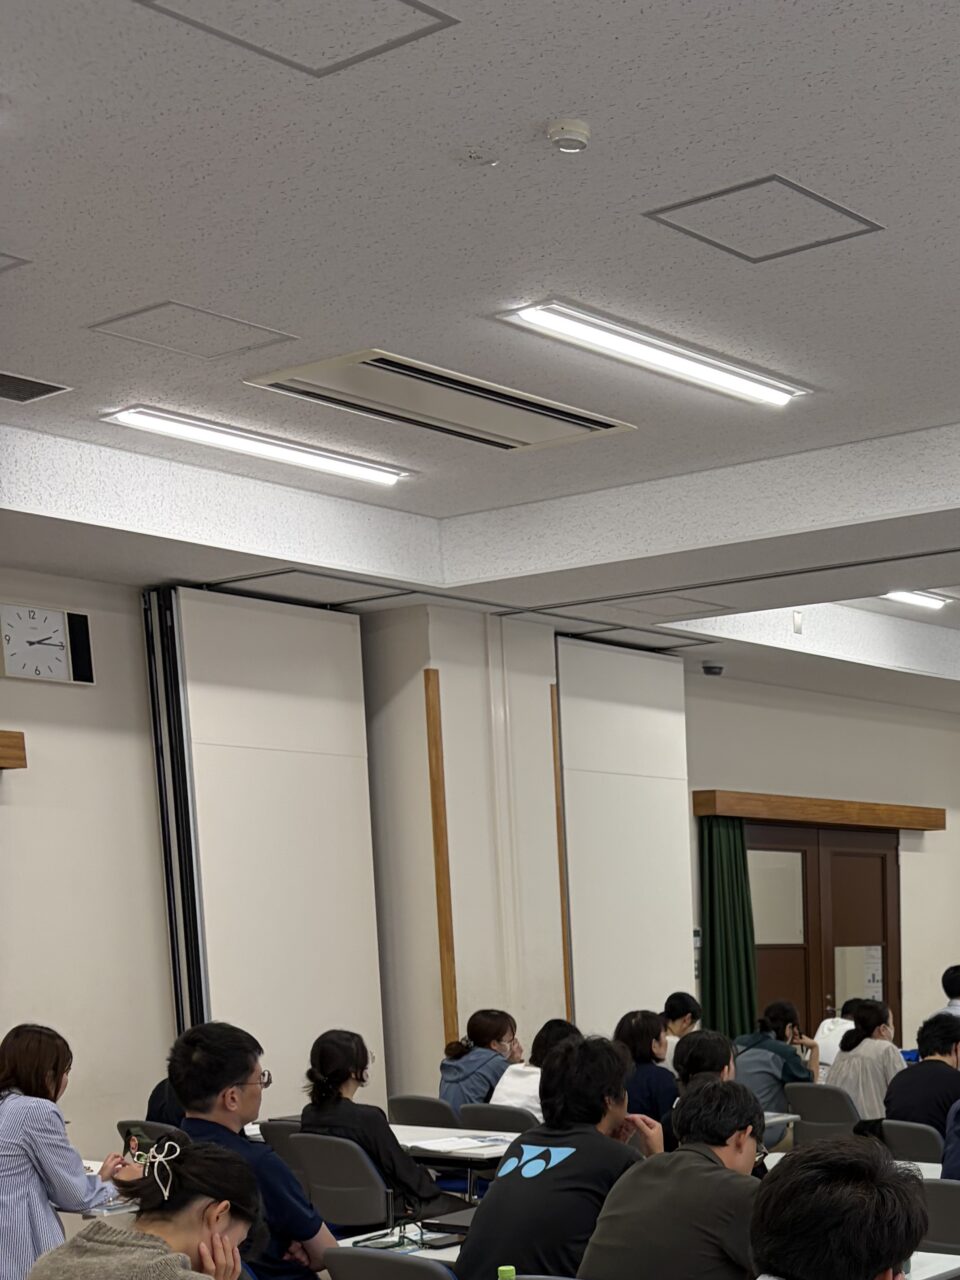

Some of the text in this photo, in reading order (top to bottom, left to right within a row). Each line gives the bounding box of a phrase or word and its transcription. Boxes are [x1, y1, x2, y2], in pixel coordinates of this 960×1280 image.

[28, 610, 36, 620] 12
[4, 634, 11, 645] 9
[34, 666, 41, 676] 6
